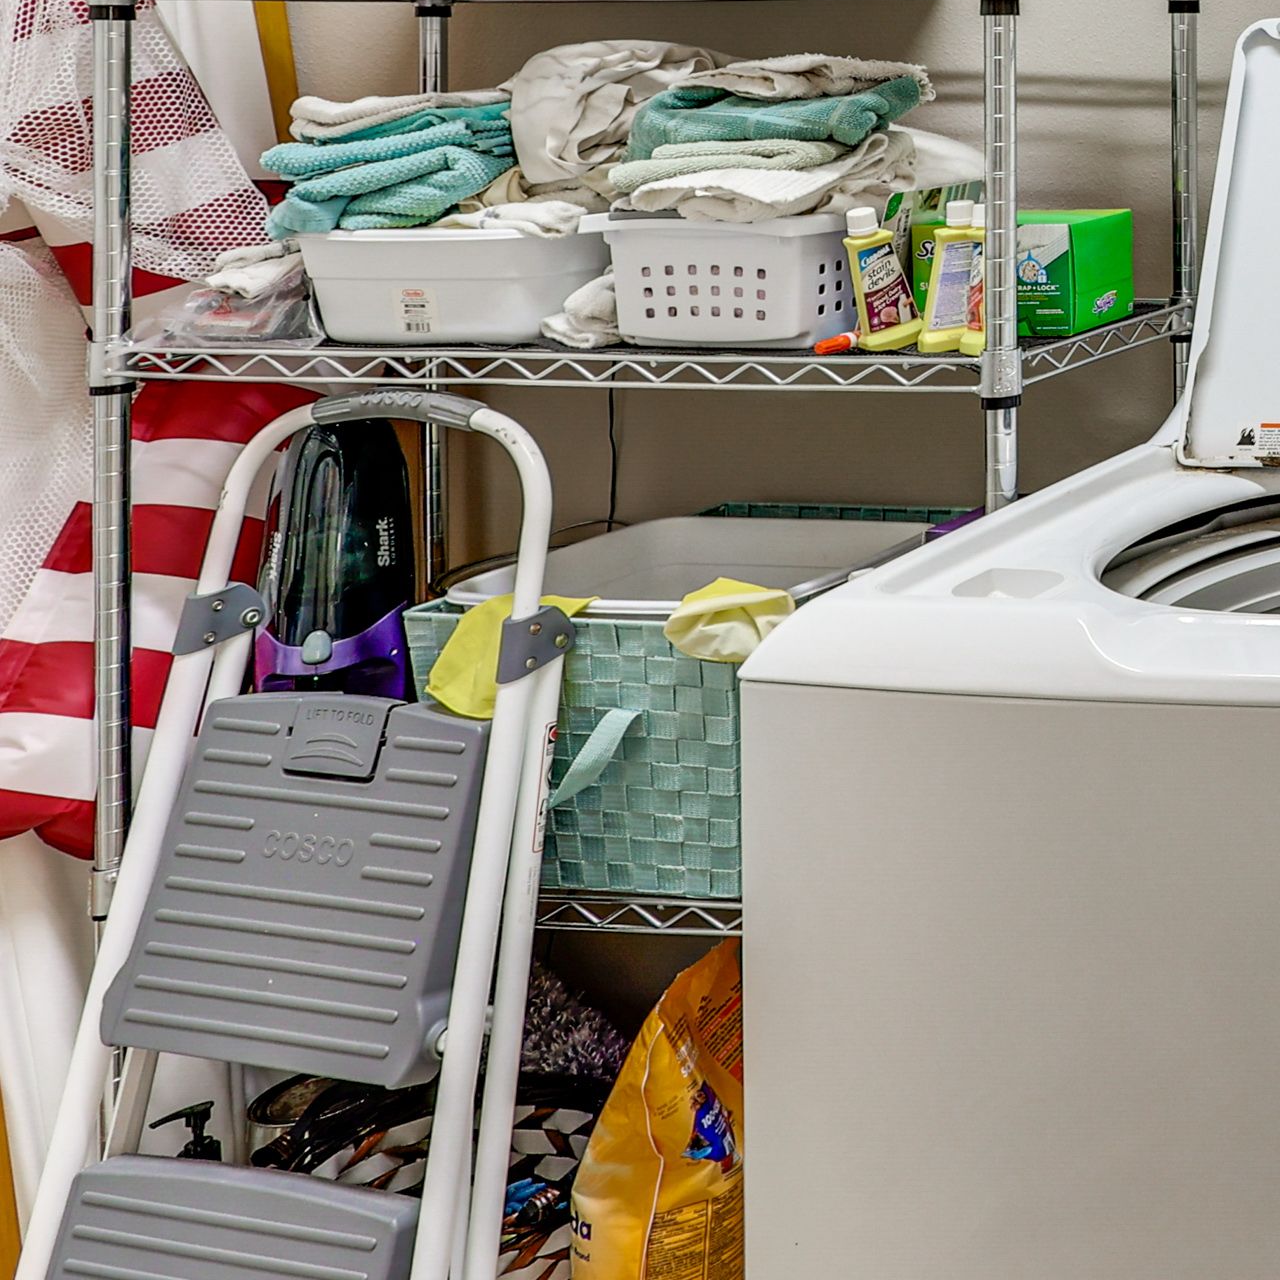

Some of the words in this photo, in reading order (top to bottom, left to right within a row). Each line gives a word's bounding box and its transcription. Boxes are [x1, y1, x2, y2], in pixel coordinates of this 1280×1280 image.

[868, 260, 891, 280] stain
[868, 267, 896, 291] devils
[376, 518, 390, 567] Shark
[306, 708, 330, 720] LIFT
[332, 710, 344, 721] TO
[348, 711, 374, 726] FOLD
[263, 829, 355, 867] COSCO
